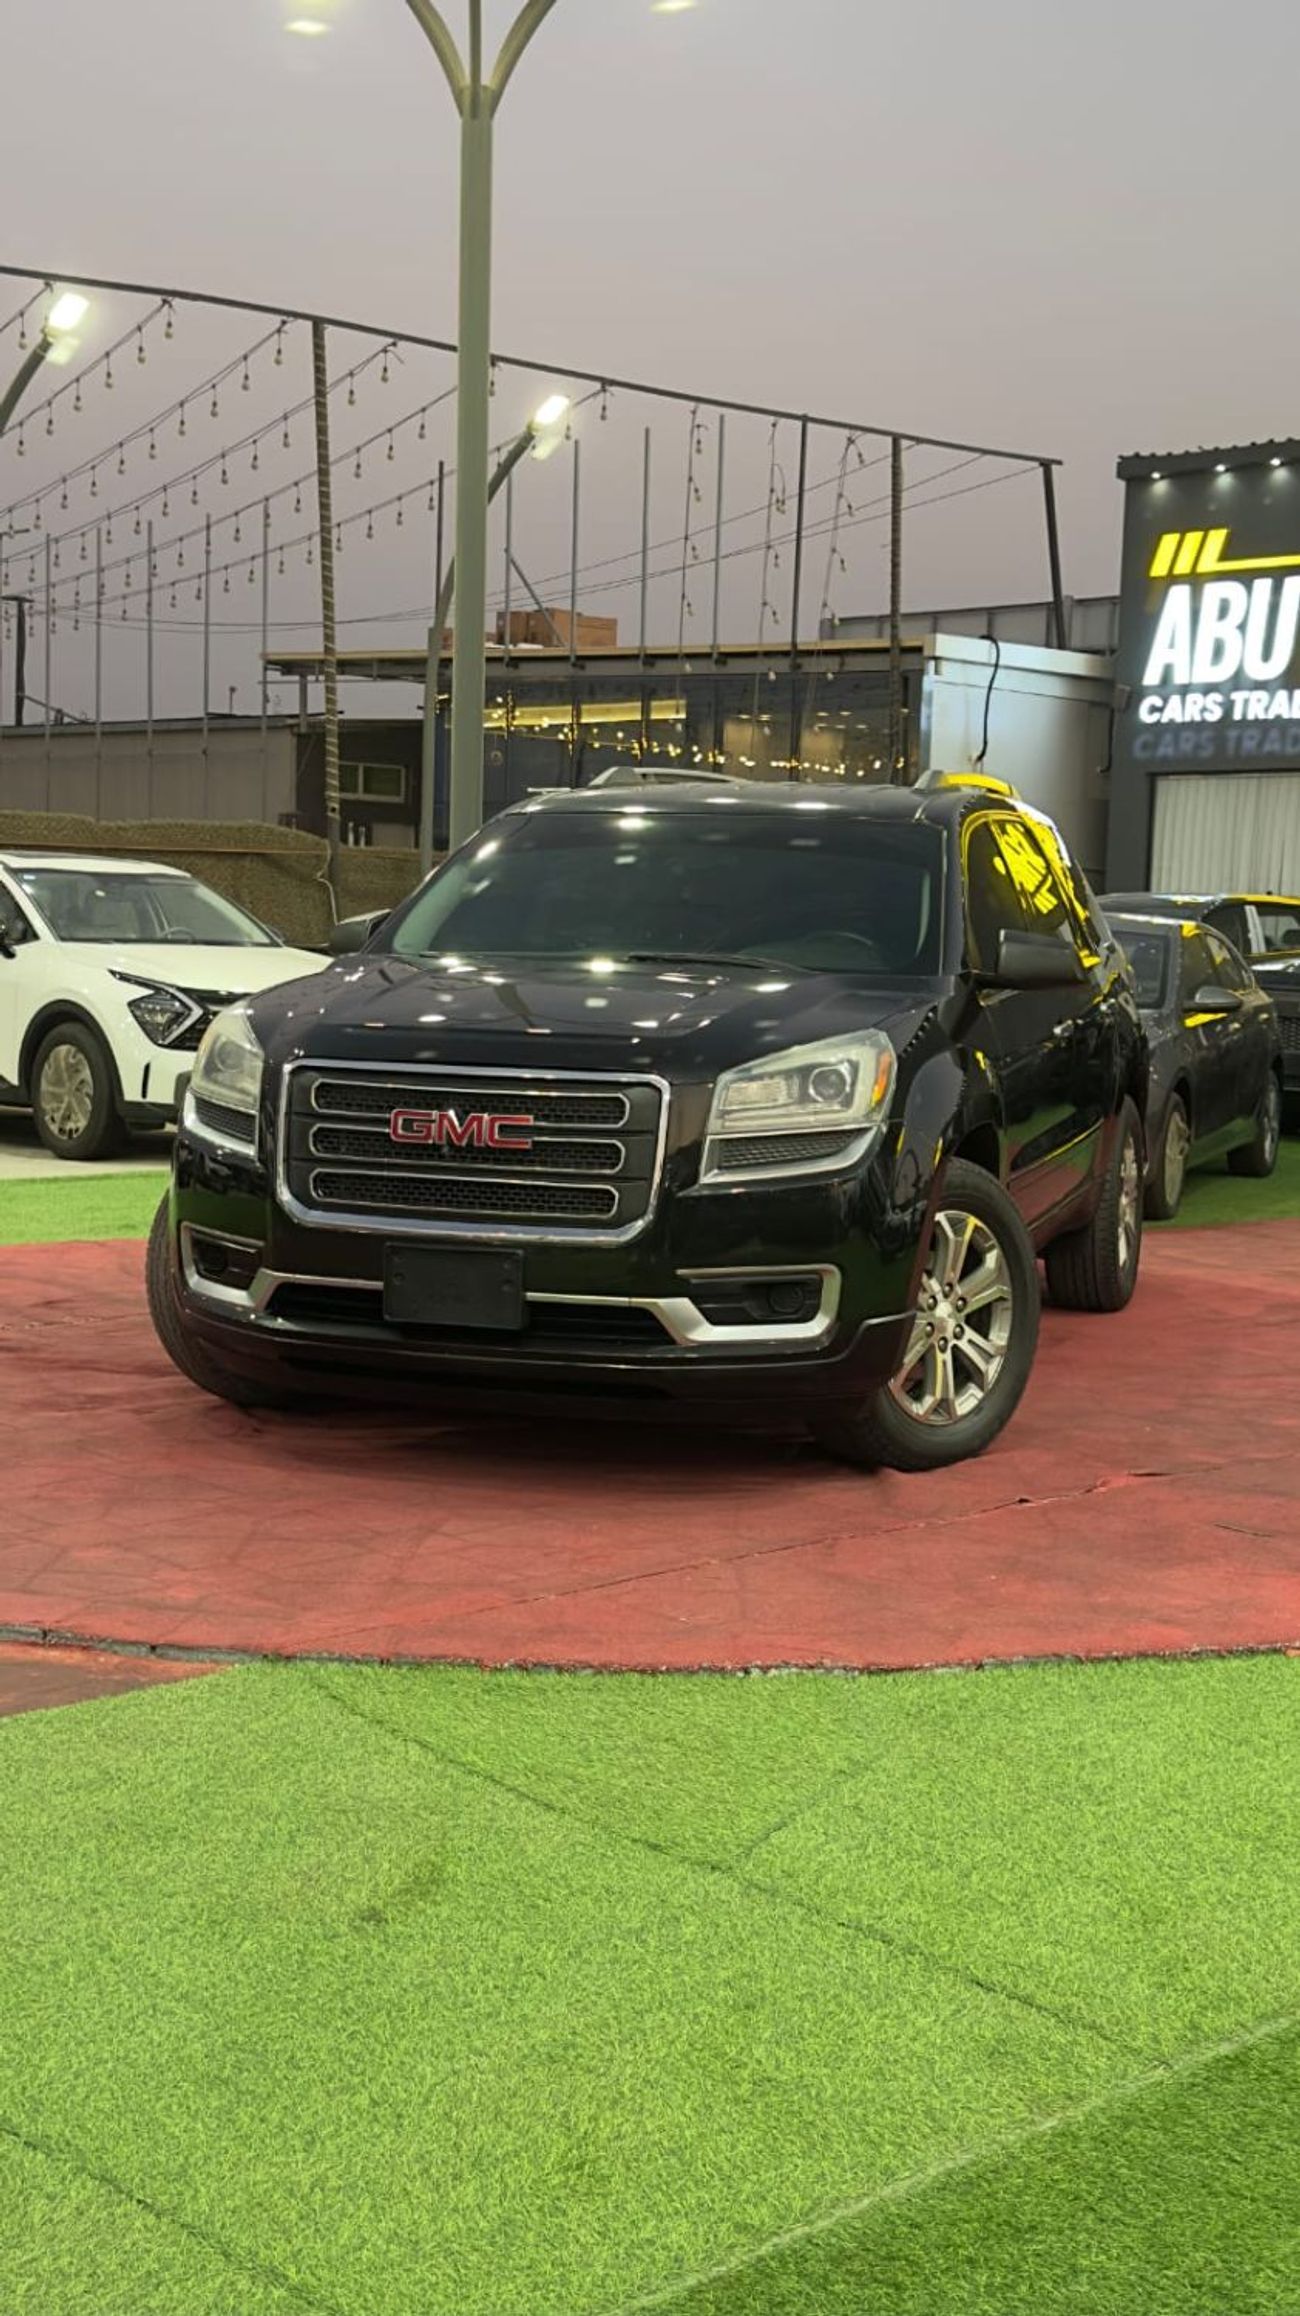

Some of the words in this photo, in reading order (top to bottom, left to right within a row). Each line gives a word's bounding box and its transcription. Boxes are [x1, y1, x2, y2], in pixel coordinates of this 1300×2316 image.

[1142, 575, 1300, 686] ABU
[1138, 693, 1224, 724] CARS
[390, 1109, 534, 1149] GMC
